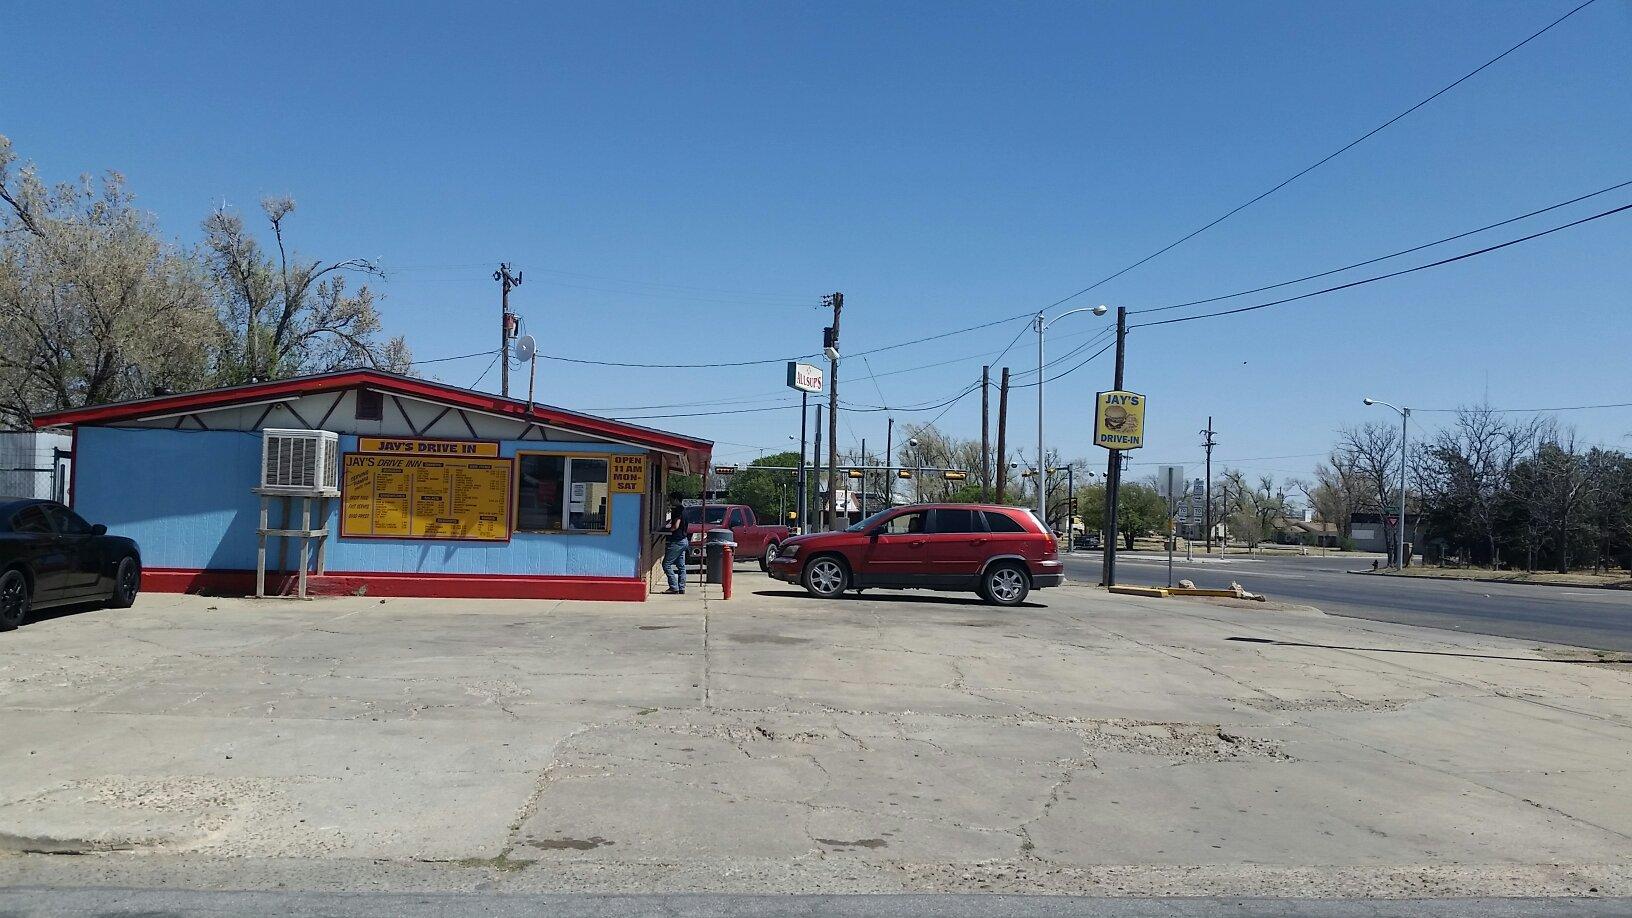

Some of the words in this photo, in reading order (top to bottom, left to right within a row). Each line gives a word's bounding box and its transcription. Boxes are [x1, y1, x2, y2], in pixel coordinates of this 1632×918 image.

[1105, 395, 1139, 406] JAY'S
[1101, 434, 1140, 444] DRIVE-IN
[378, 441, 414, 451] JAY'S
[418, 443, 458, 453] DRIVE
[462, 444, 477, 453] IN
[346, 457, 375, 467] JAY'S
[377, 459, 404, 467] DRIVE
[405, 460, 422, 468] INN
[614, 456, 642, 464] OPEN
[613, 473, 642, 481] MON-
[617, 482, 638, 490] SAT
